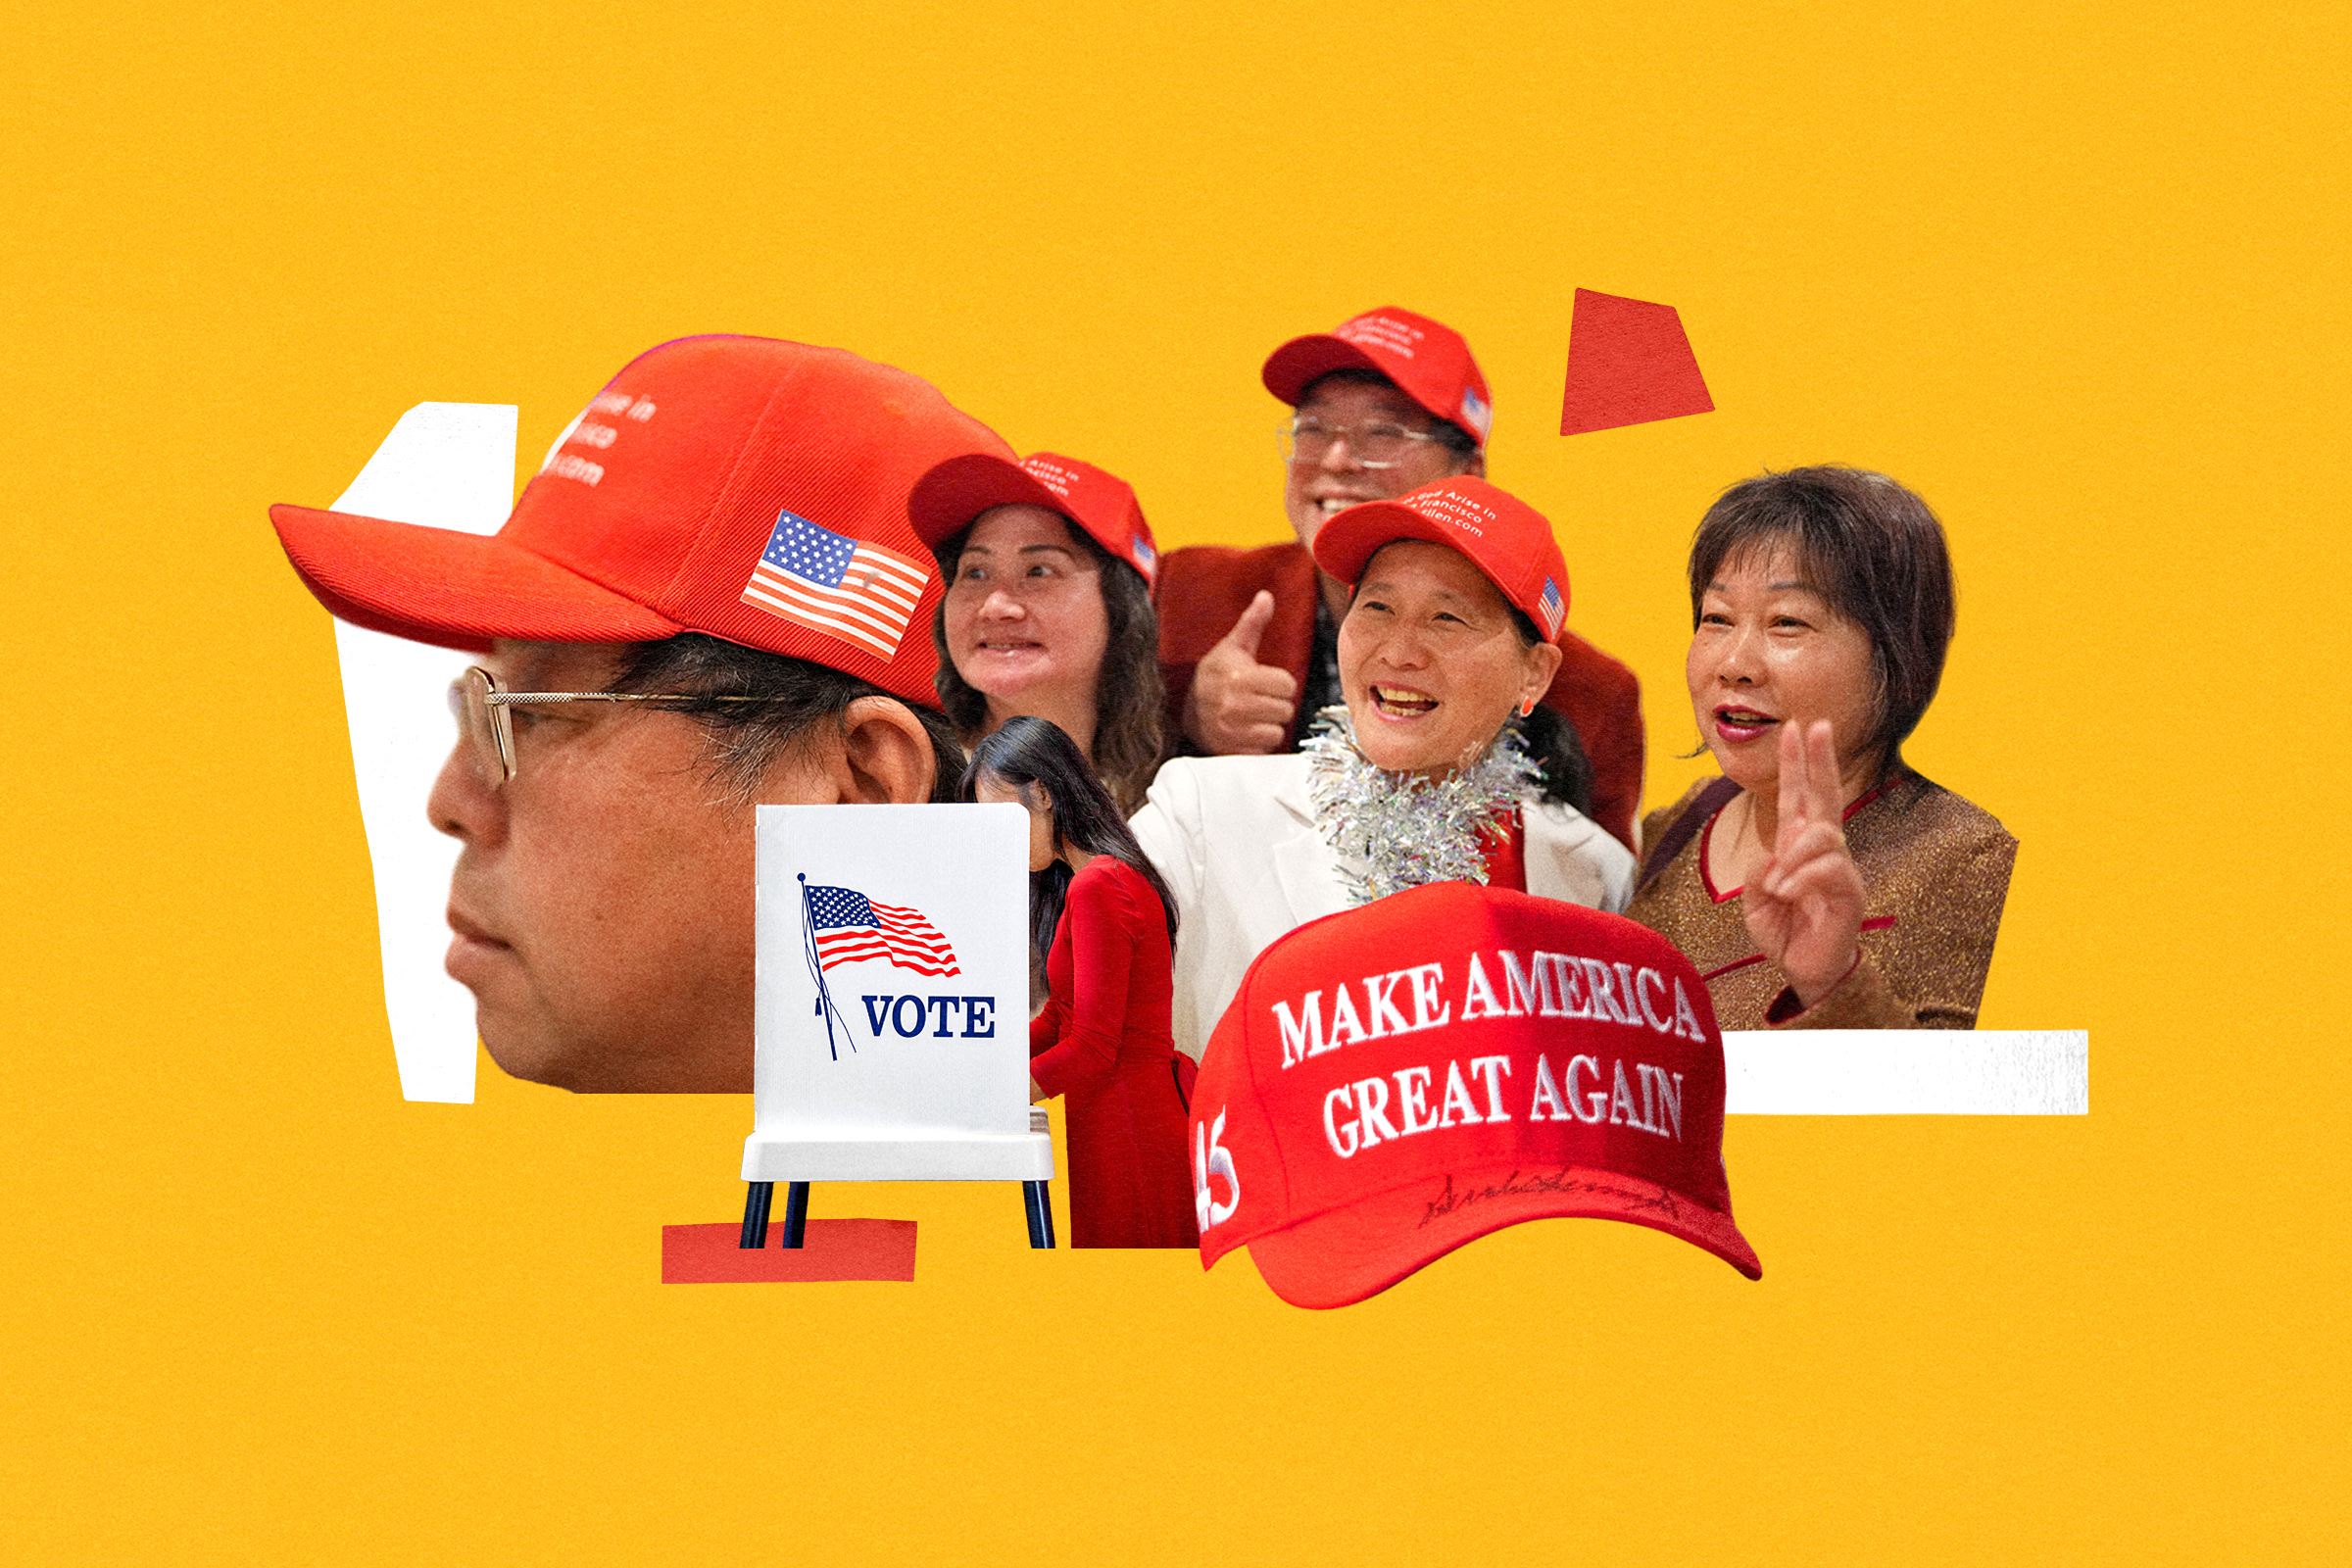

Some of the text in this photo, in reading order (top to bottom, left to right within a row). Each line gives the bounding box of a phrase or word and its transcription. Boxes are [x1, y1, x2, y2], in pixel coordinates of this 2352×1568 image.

[1446, 491, 1481, 510] Arise
[861, 995, 996, 1039] VOTE
[1272, 949, 1706, 1070] MAKE AMERICA
[1323, 1053, 1684, 1158] GREAT AGAIN
